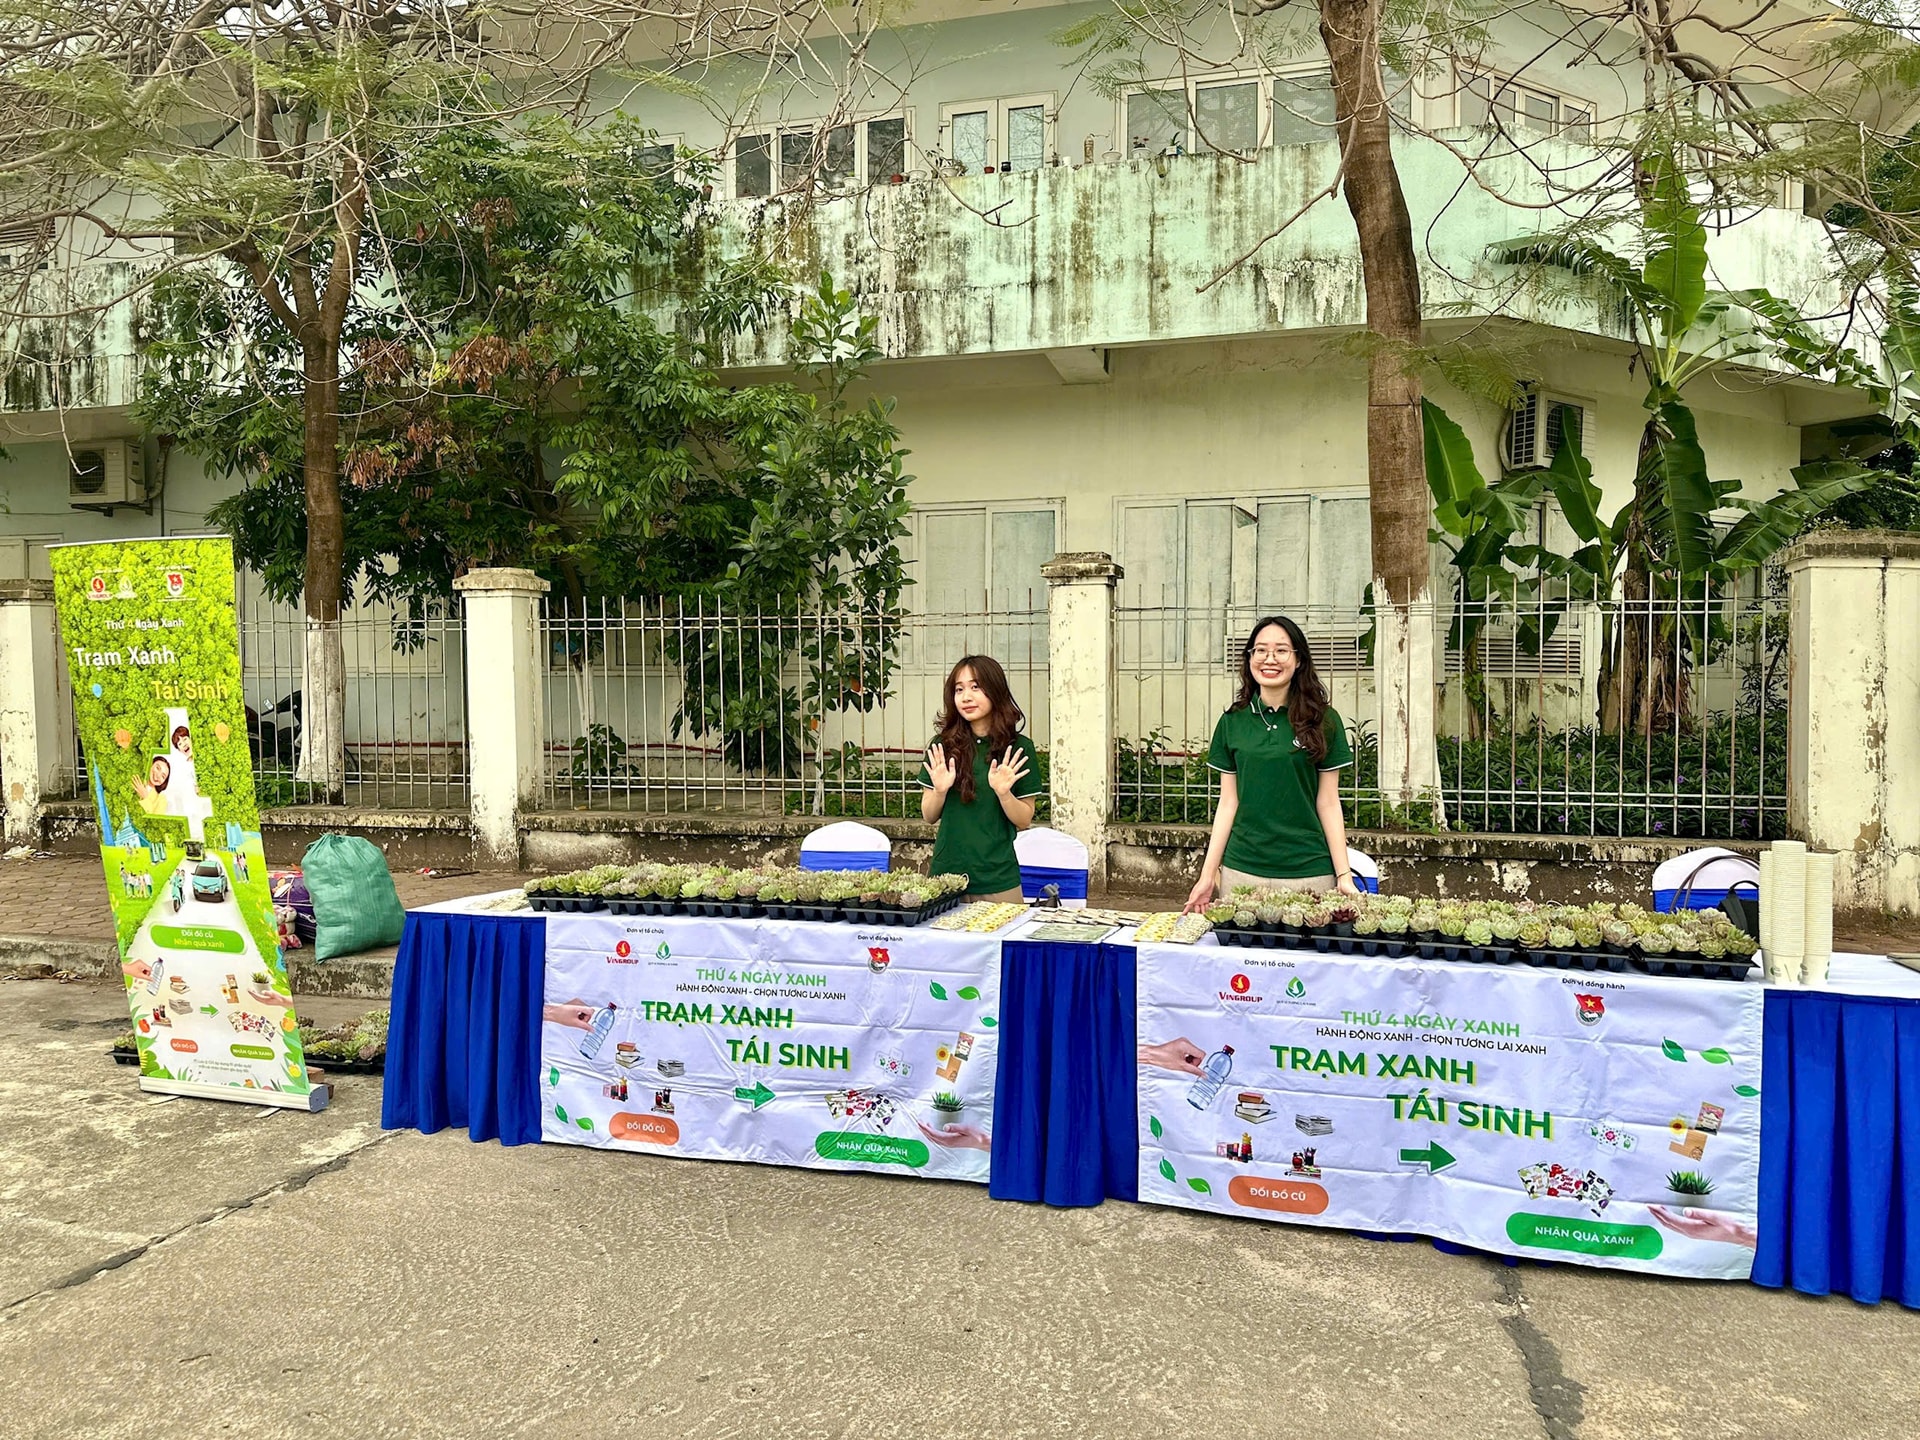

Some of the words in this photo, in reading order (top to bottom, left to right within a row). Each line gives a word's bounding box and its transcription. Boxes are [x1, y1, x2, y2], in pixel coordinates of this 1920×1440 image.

[127, 619, 134, 629] 4
[135, 619, 159, 631] Ngày
[161, 617, 185, 628] Xanh
[72, 647, 122, 671] Trạm
[127, 644, 176, 665] Xanh
[151, 679, 180, 700] Tái
[184, 679, 229, 700] Sinh
[606, 956, 639, 965] VINGROUP
[1277, 960, 1295, 968] chức
[696, 967, 726, 981] THỨ
[728, 971, 738, 983] 4
[741, 968, 782, 985] NGÀY
[785, 973, 827, 987] XANH
[676, 983, 699, 992] HÀNH
[701, 983, 726, 994] ĐỘNG
[726, 986, 748, 995] XANH
[753, 988, 778, 998] CHỌN
[779, 988, 808, 999] TƯƠNG
[809, 990, 822, 999] LAI
[822, 991, 846, 1000] XANH
[1218, 991, 1263, 1003] VINGROUP
[641, 1000, 714, 1028] TRẠM
[719, 1004, 795, 1029] XANH
[1341, 1009, 1382, 1026] THỨ
[1386, 1014, 1399, 1027] 4
[1404, 1011, 1458, 1030] NGÀY
[1463, 1018, 1520, 1037] XANH
[1316, 1027, 1347, 1038] HÀNH
[1349, 1029, 1381, 1042] ĐỘNG
[1383, 1031, 1413, 1042] XANH
[1421, 1033, 1453, 1046] CHỌN
[1455, 1036, 1495, 1050] TƯƠNG
[1497, 1040, 1513, 1051] LAI
[1515, 1043, 1547, 1055] XANH
[726, 1034, 771, 1065] TÁI
[778, 1043, 850, 1070] SINH
[1270, 1045, 1367, 1079] TRẠM
[1376, 1053, 1476, 1085] XANH
[1386, 1088, 1447, 1122] TÁI
[1457, 1100, 1553, 1139] SINH
[885, 1145, 908, 1156] XANH
[1534, 1226, 1570, 1239] NHẬN
[1572, 1230, 1600, 1243] QUÀ
[1602, 1234, 1635, 1245] XANH
